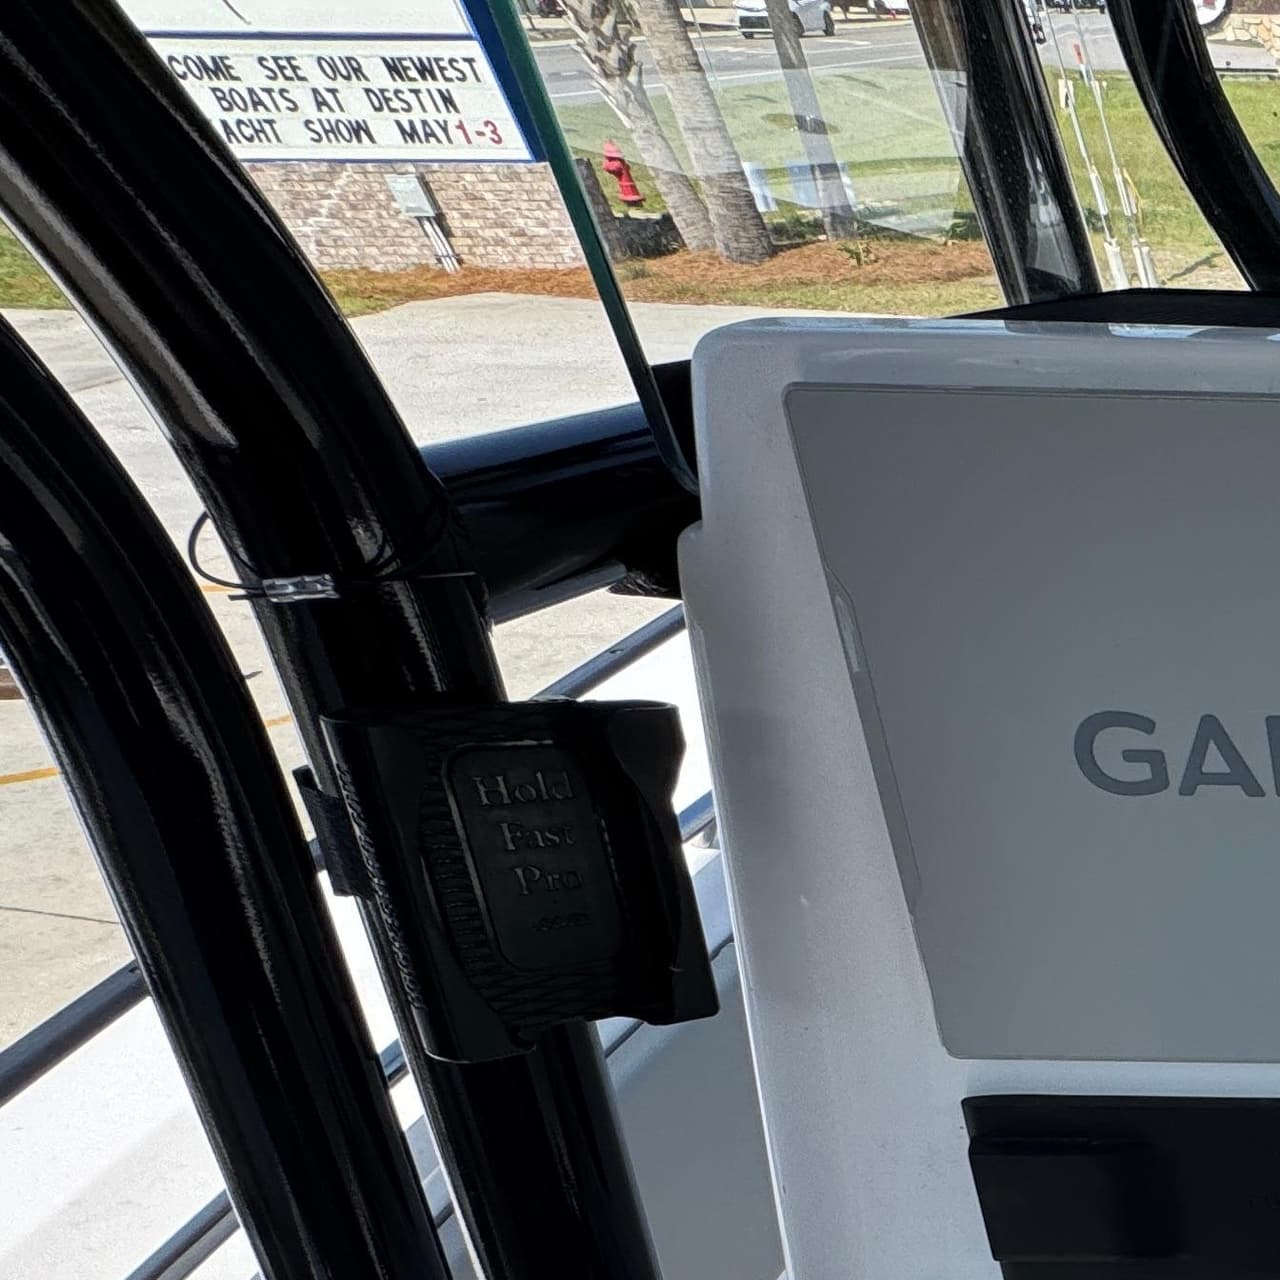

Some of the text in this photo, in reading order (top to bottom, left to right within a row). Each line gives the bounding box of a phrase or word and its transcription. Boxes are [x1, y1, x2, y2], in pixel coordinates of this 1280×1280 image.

[167, 55, 484, 83] COME SEE OUR NEWEST
[209, 87, 461, 114] BOATS AT DESTIN
[210, 118, 503, 145] ACHT SHOW MAY 1-3
[471, 769, 576, 807] Hold
[500, 821, 576, 851] Fast
[514, 864, 583, 896] Pro
